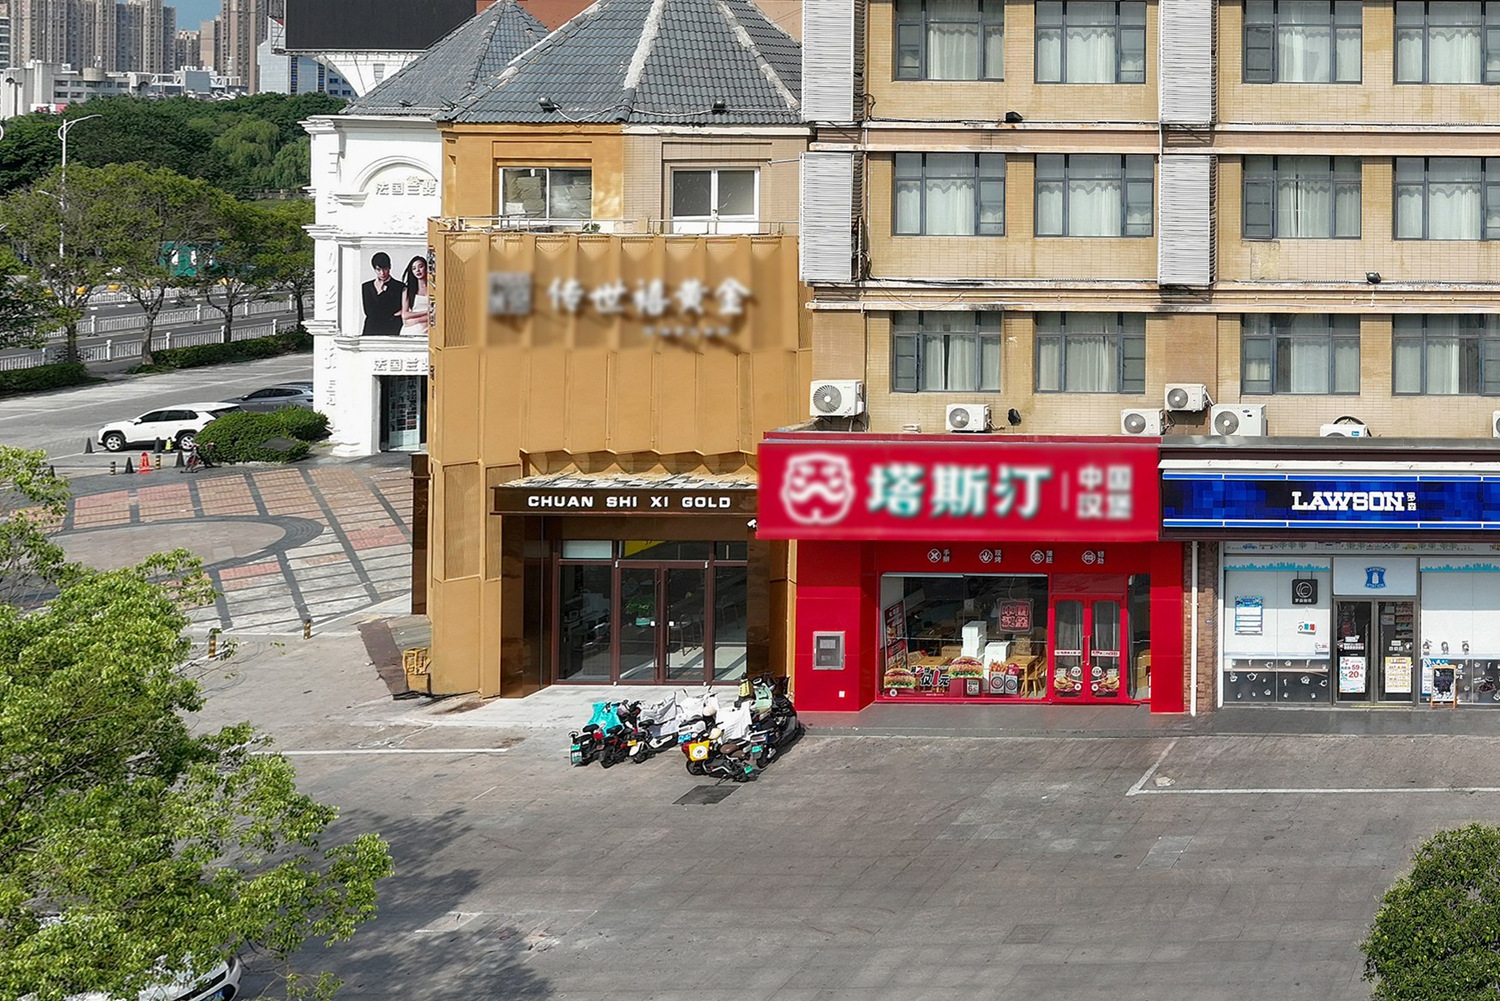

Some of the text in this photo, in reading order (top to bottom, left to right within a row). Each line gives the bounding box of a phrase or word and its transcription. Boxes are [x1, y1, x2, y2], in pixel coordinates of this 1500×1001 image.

[1077, 465, 1133, 490] 中国
[867, 463, 1051, 517] 塔斯汀
[1291, 491, 1405, 511] LAWSON
[527, 496, 732, 508] CHUAN SHI XI GOLD
